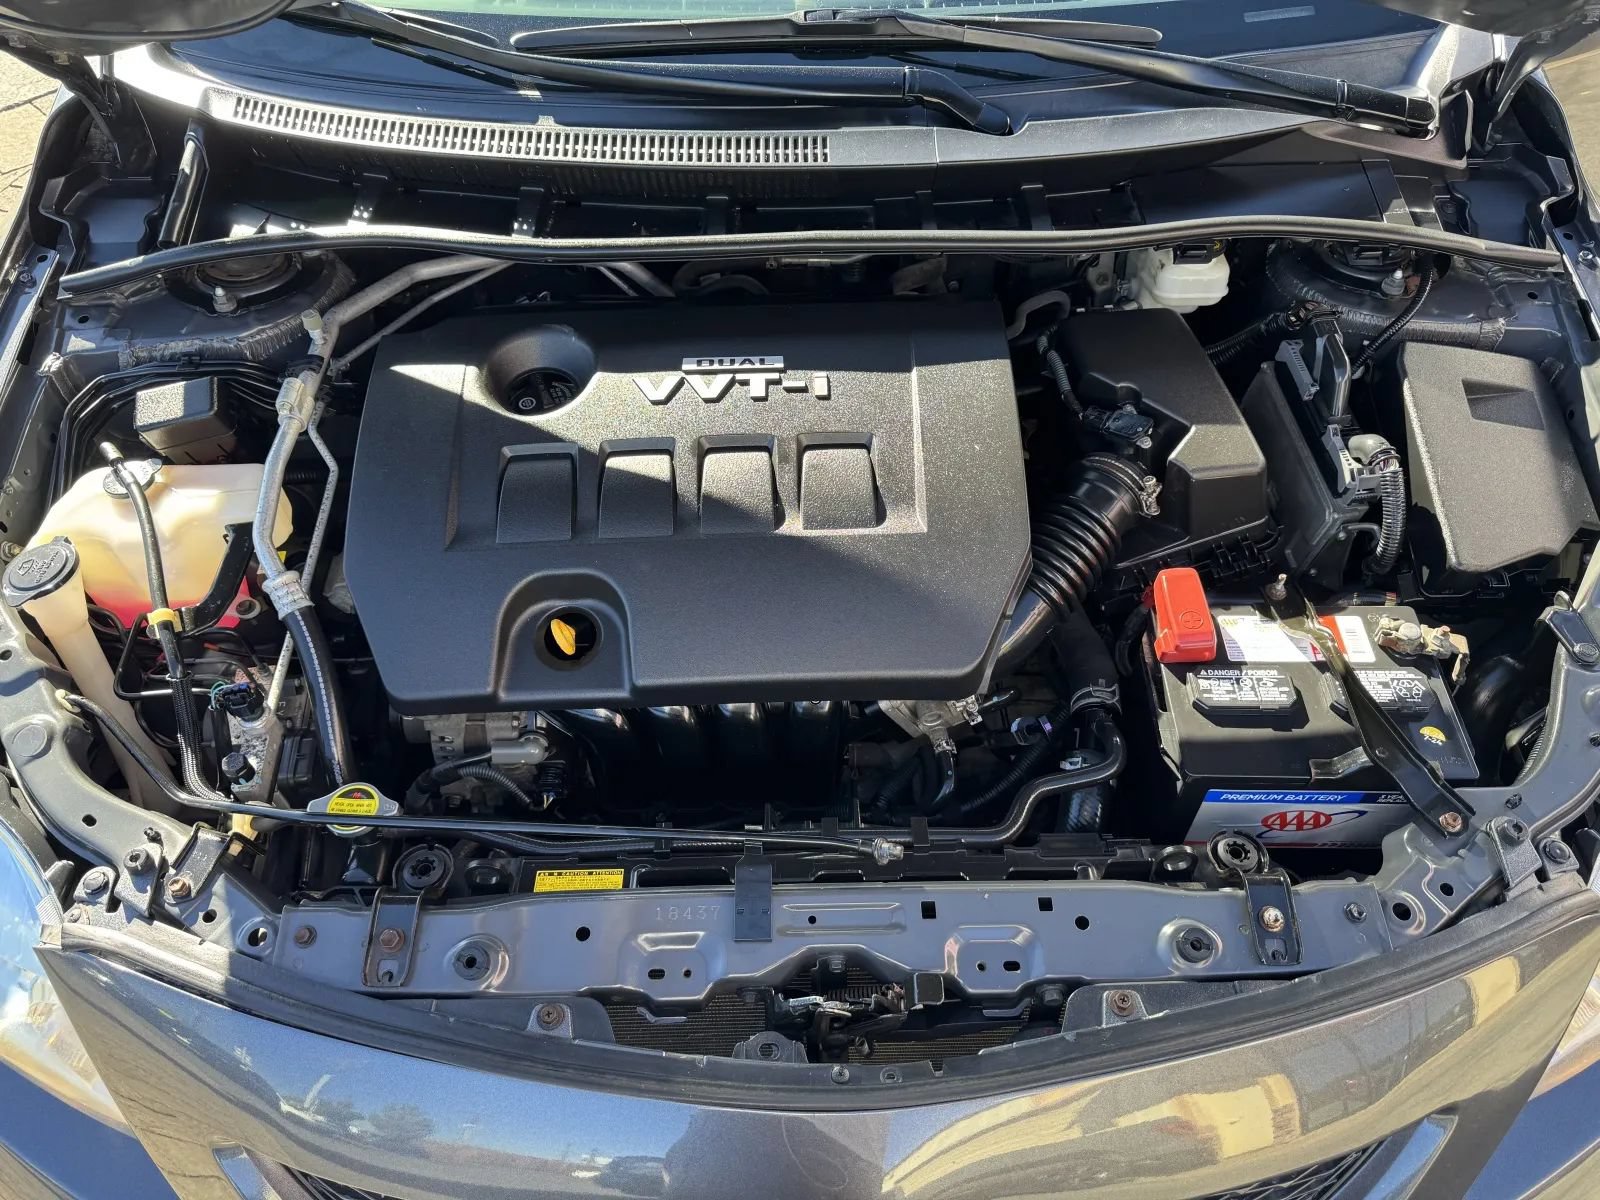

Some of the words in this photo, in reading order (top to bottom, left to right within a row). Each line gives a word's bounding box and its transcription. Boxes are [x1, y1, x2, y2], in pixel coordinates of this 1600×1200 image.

[696, 357, 775, 368] DUAL
[1220, 793, 1285, 801] PREMIUM
[1285, 794, 1347, 802] BATTERY
[1263, 810, 1331, 831] AAA
[656, 905, 721, 920] 18437
